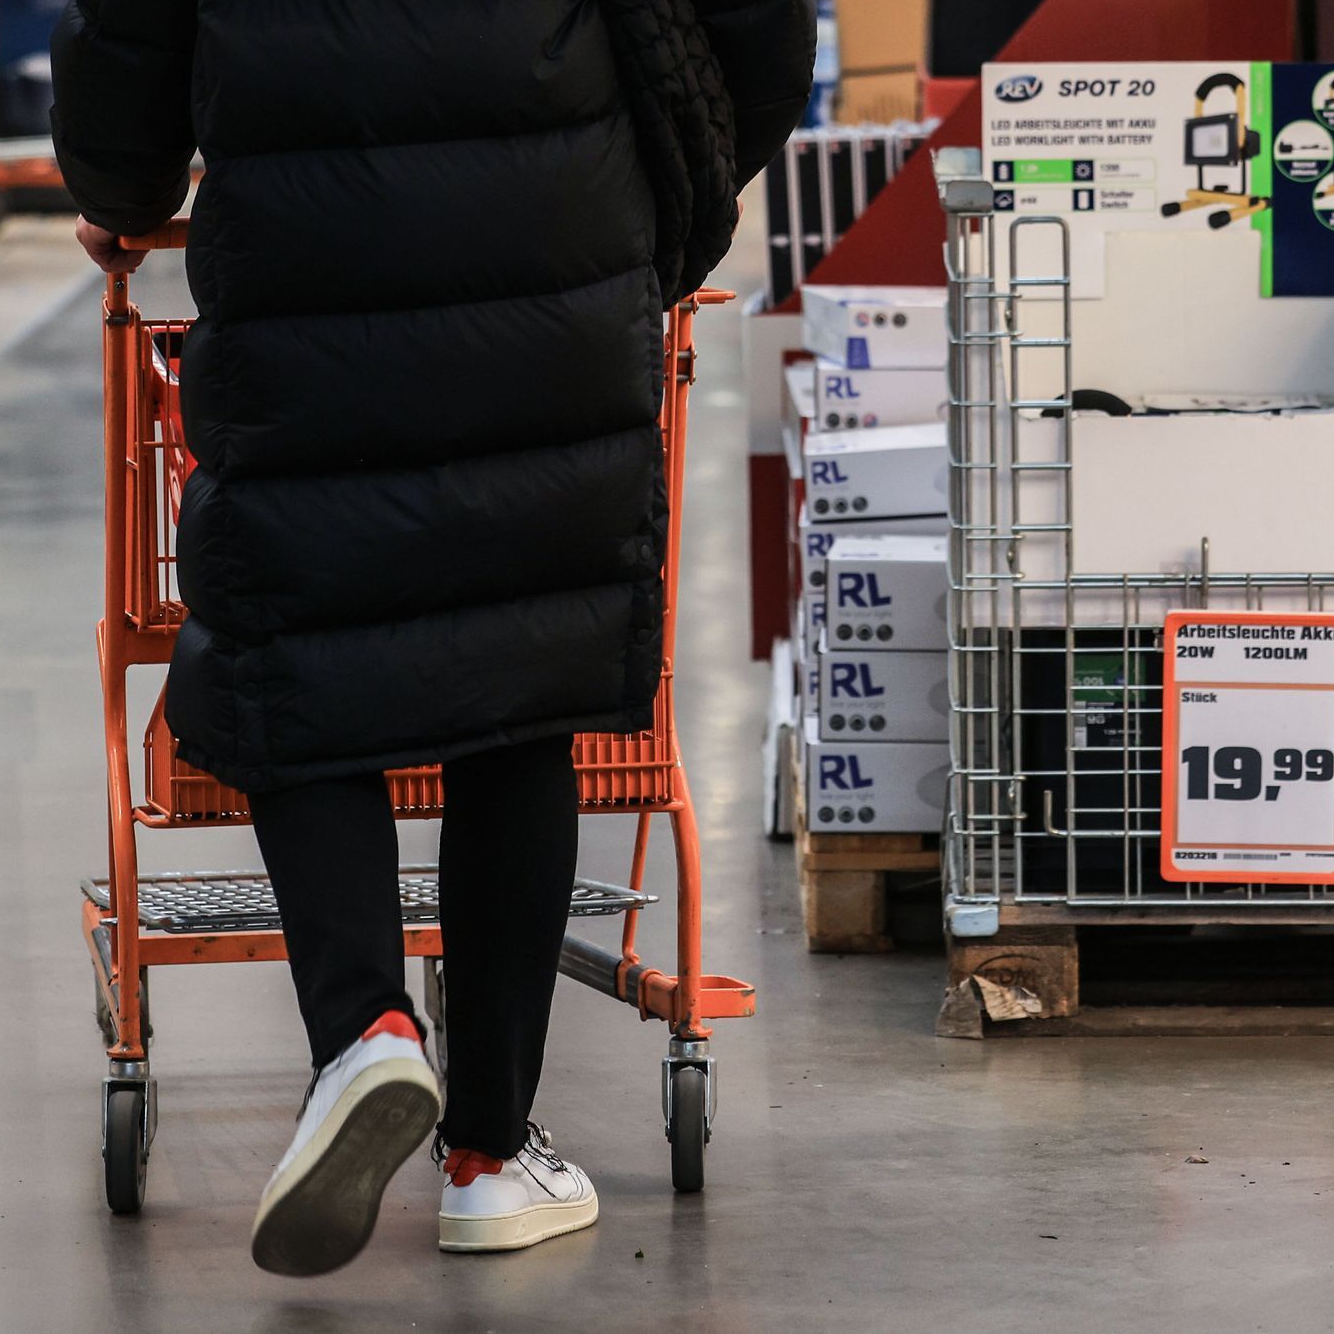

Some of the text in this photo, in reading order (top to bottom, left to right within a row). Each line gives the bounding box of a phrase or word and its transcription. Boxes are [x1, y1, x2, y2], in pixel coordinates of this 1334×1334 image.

[997, 77, 1043, 99] REV
[1058, 79, 1156, 97] SPOT 20
[990, 119, 1157, 131] LED ARBEITSLEUCHTE MIT AKKU
[990, 134, 1153, 147] LED WORKLIGHT WITH BATTERY
[825, 375, 861, 399] RL
[811, 460, 849, 484] RL
[838, 572, 892, 608] RL
[1177, 624, 1295, 641] Arbeitsleuchte
[1177, 645, 1308, 660] 20W 1200LM
[830, 663, 885, 698] RL
[1181, 692, 1218, 704] Stück
[819, 755, 874, 790] RL
[1181, 746, 1334, 802] 19,99
